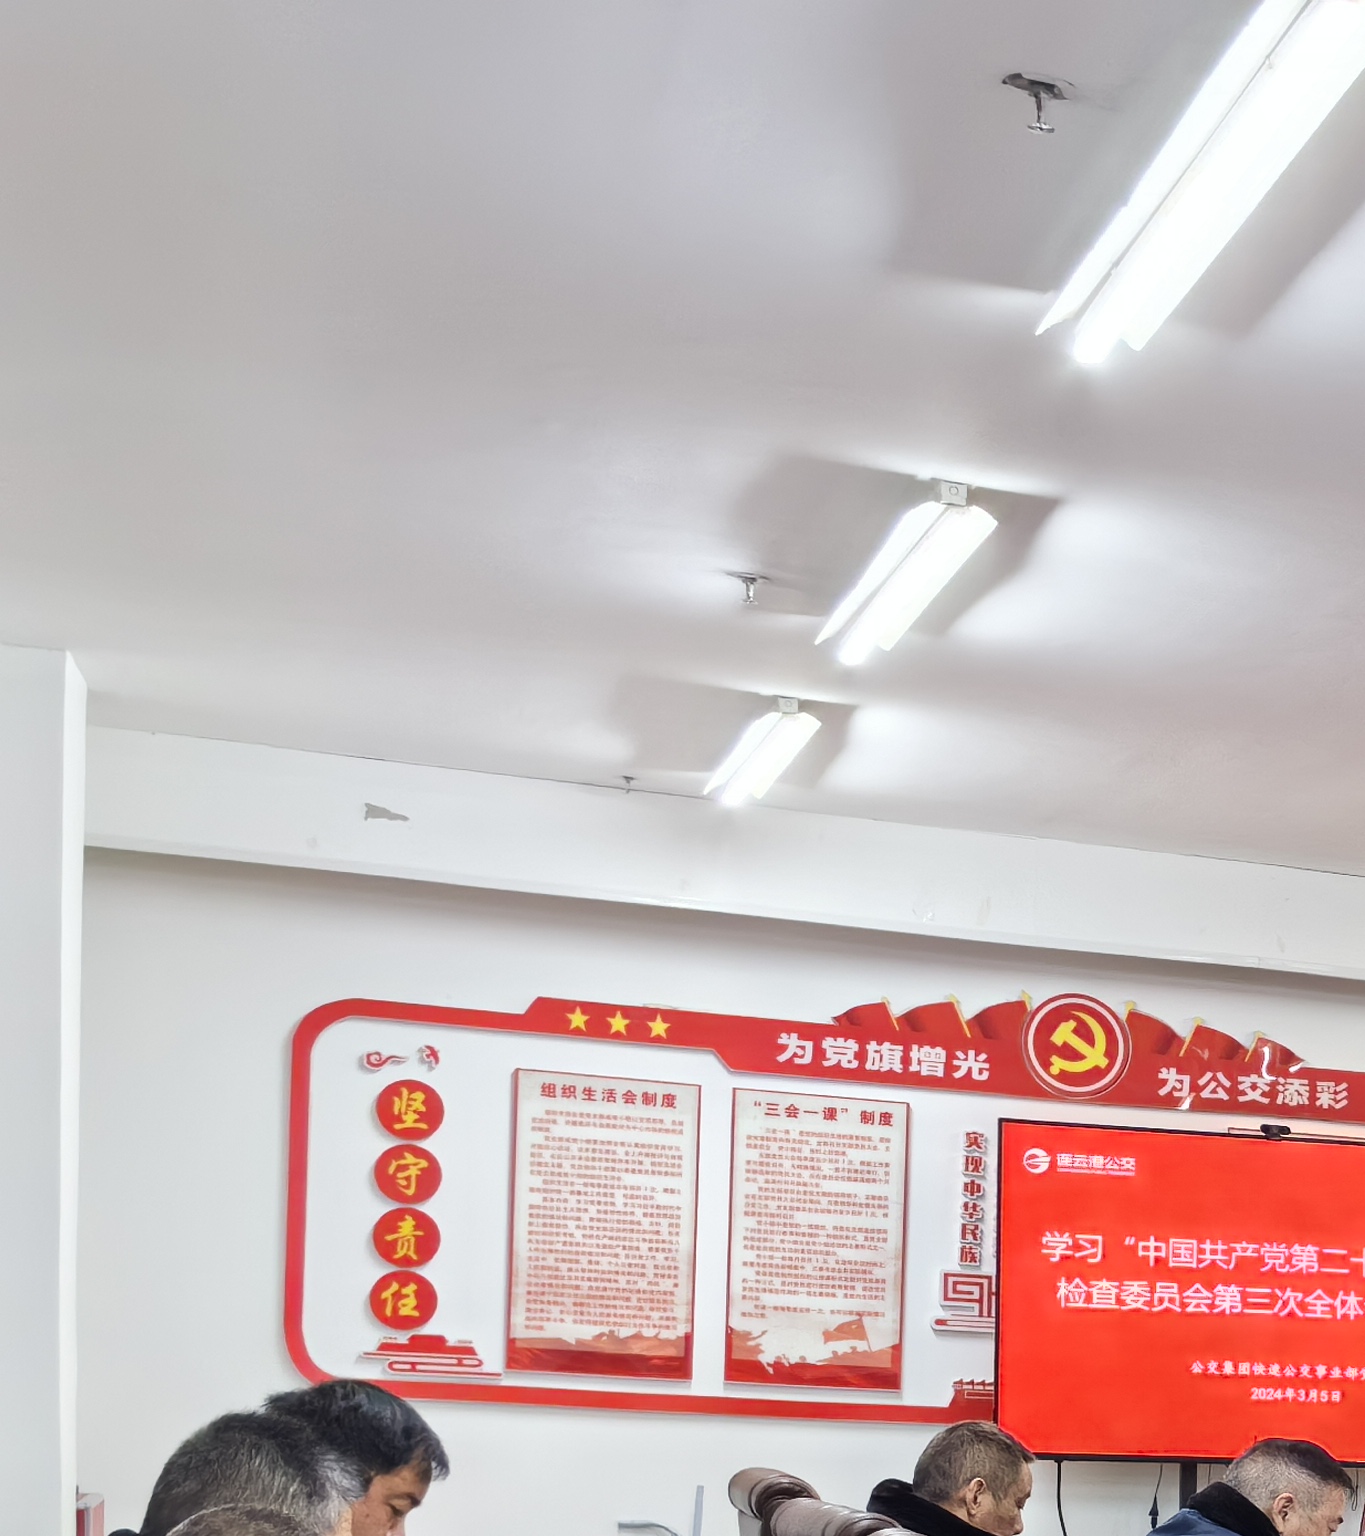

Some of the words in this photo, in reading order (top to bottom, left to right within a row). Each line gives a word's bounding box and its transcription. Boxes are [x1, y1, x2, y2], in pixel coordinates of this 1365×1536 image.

[776, 1032, 990, 1081] 为党旗增光
[540, 1082, 677, 1109] 组织生活会制度
[1157, 1067, 1349, 1109] 为公交添彩
[380, 1087, 430, 1318] 坚守责任
[958, 1130, 986, 1265] 实现中华民族
[1250, 1386, 1342, 1402] 2024年3月5日
